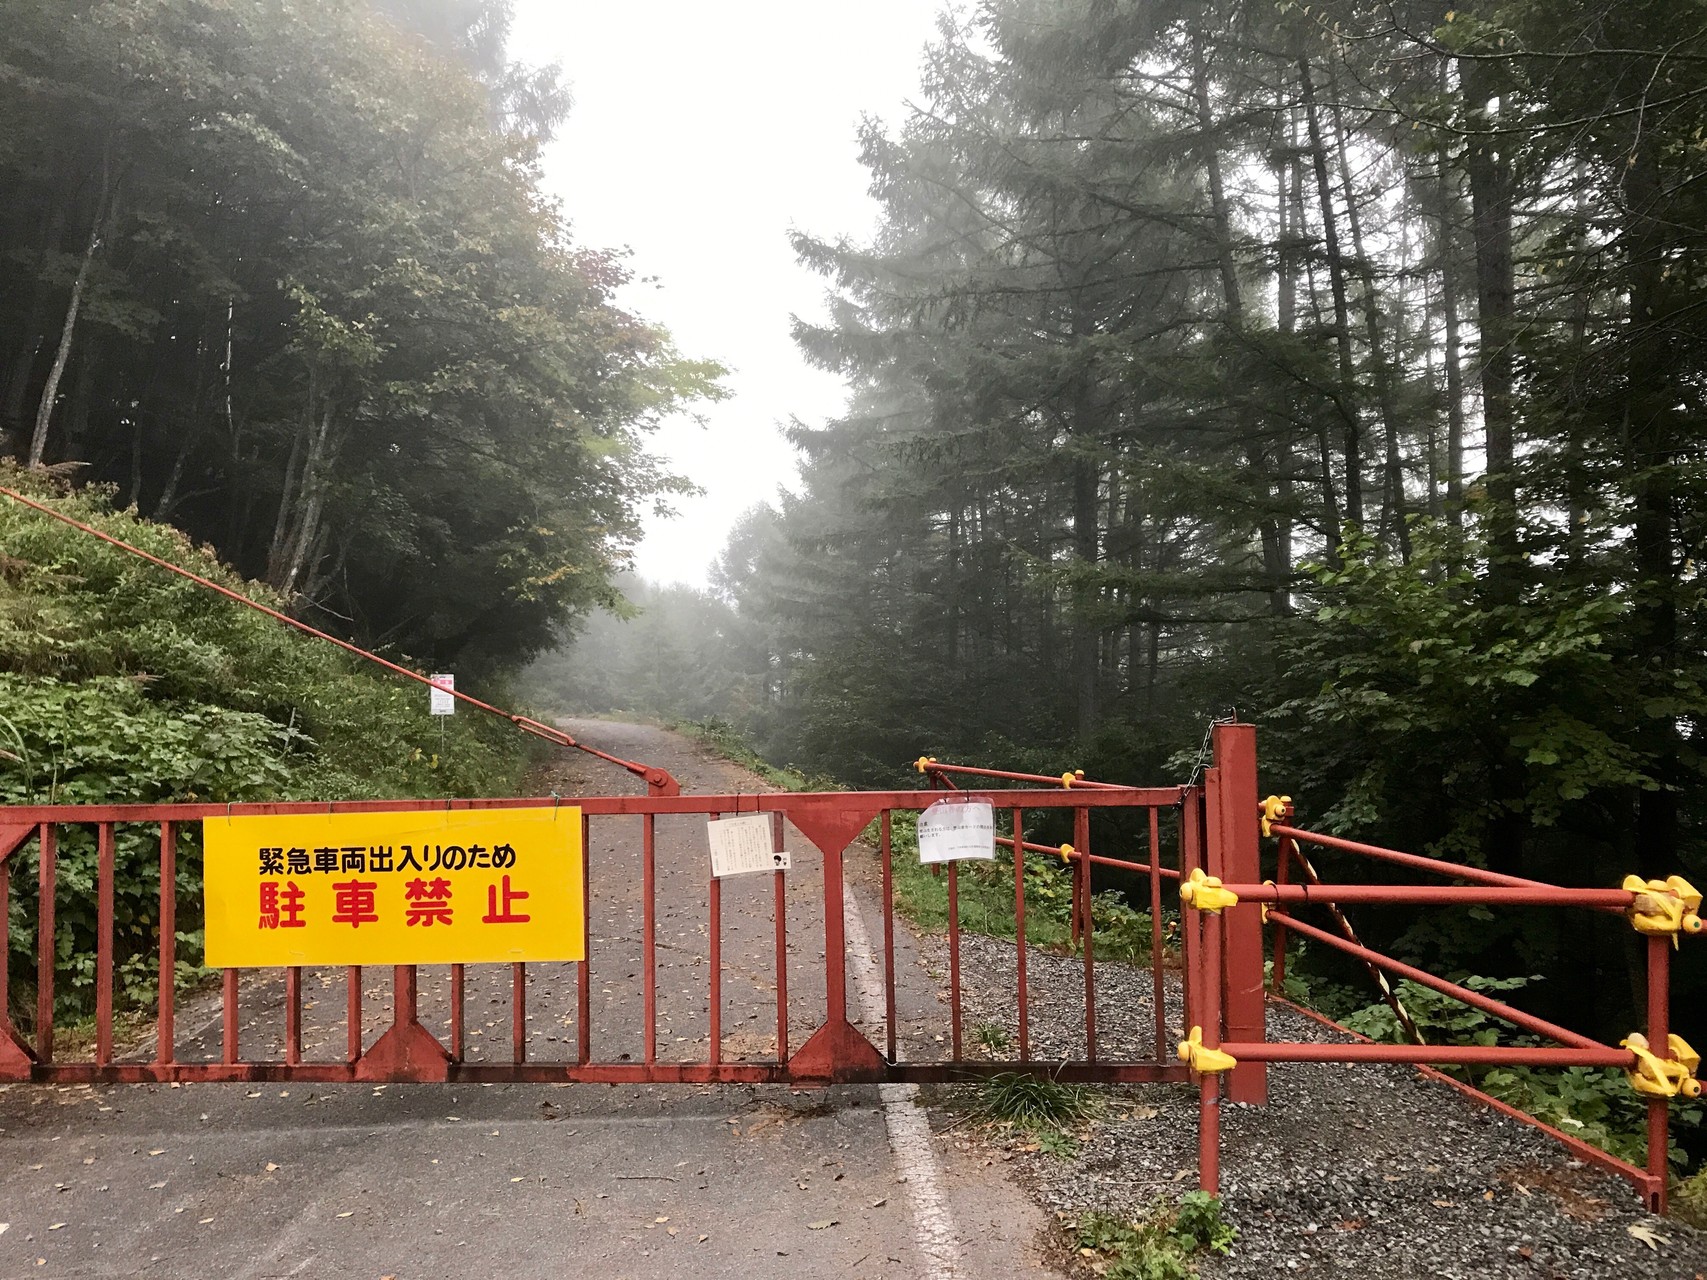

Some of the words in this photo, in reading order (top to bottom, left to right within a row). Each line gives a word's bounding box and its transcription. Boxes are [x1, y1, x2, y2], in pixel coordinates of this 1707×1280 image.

[258, 843, 516, 875] 緊急車両出入りのため
[258, 874, 531, 930] 駐車禁止
